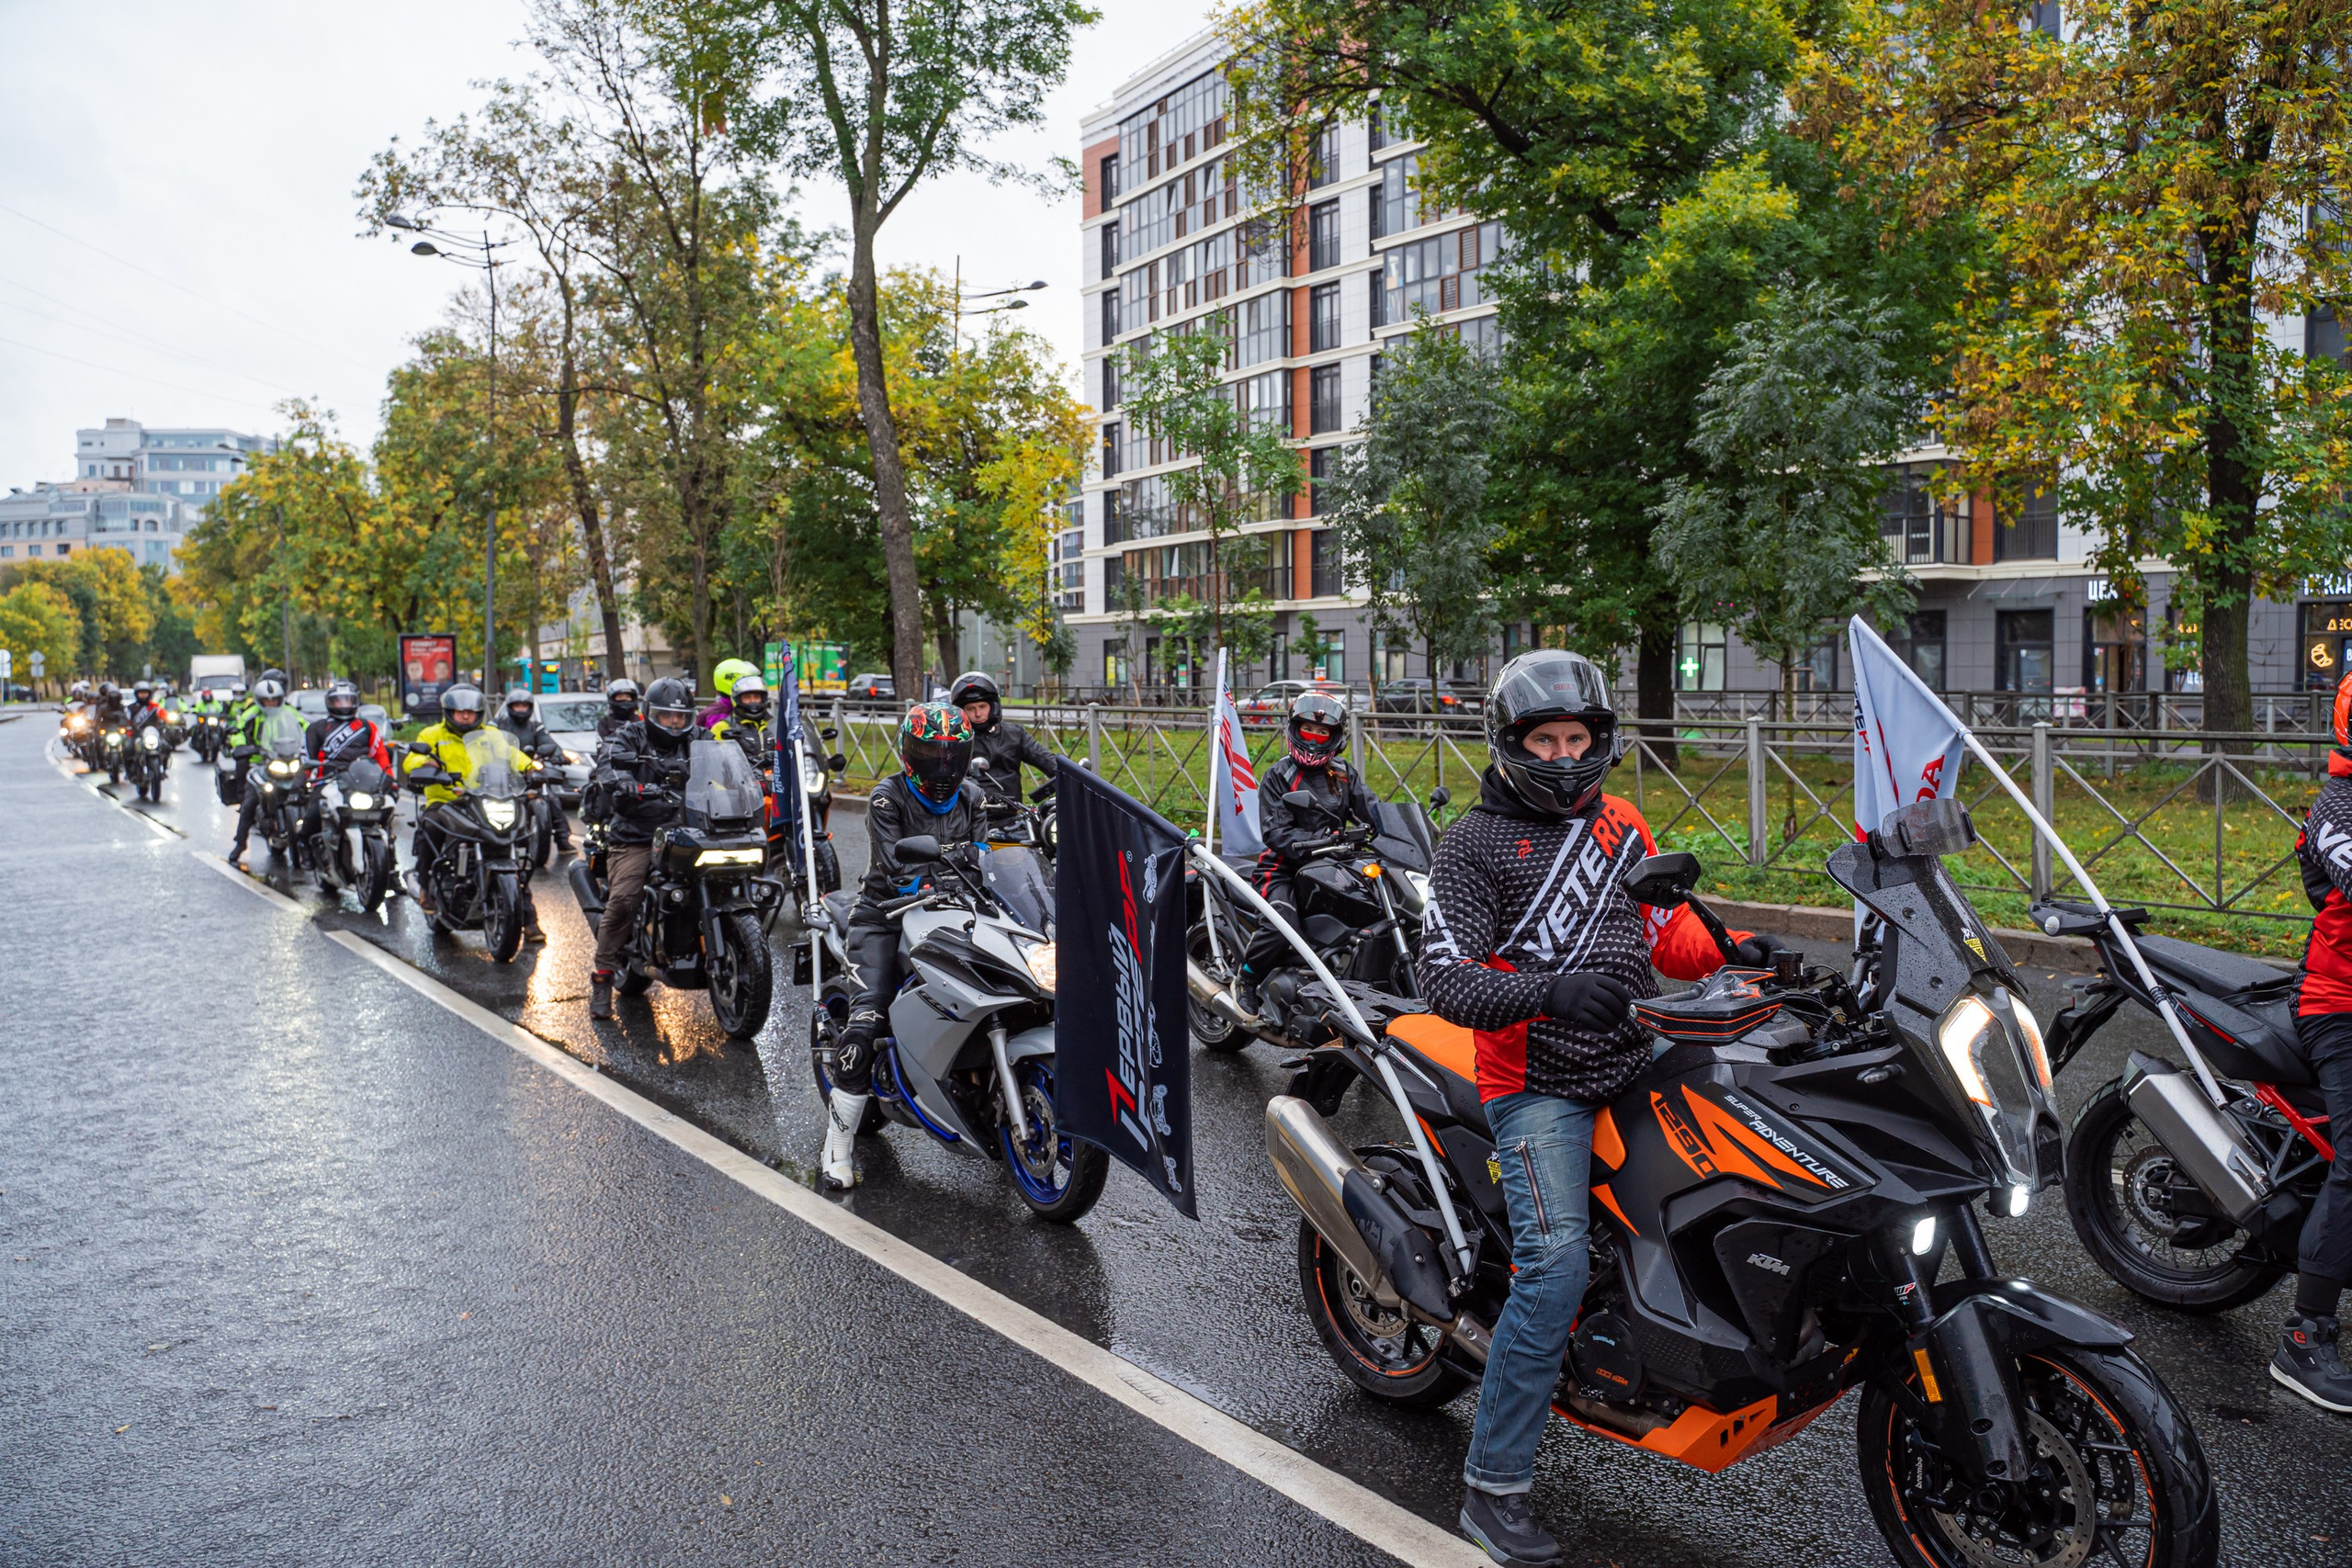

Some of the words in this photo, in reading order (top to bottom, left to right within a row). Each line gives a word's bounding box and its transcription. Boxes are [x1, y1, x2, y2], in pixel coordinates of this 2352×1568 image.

[1724, 1094, 1762, 1121] SUPER
[1749, 1120, 1849, 1189] ADVENTURE
[1746, 1253, 1791, 1276] KTM
[1915, 1456, 1923, 1489] brembo
